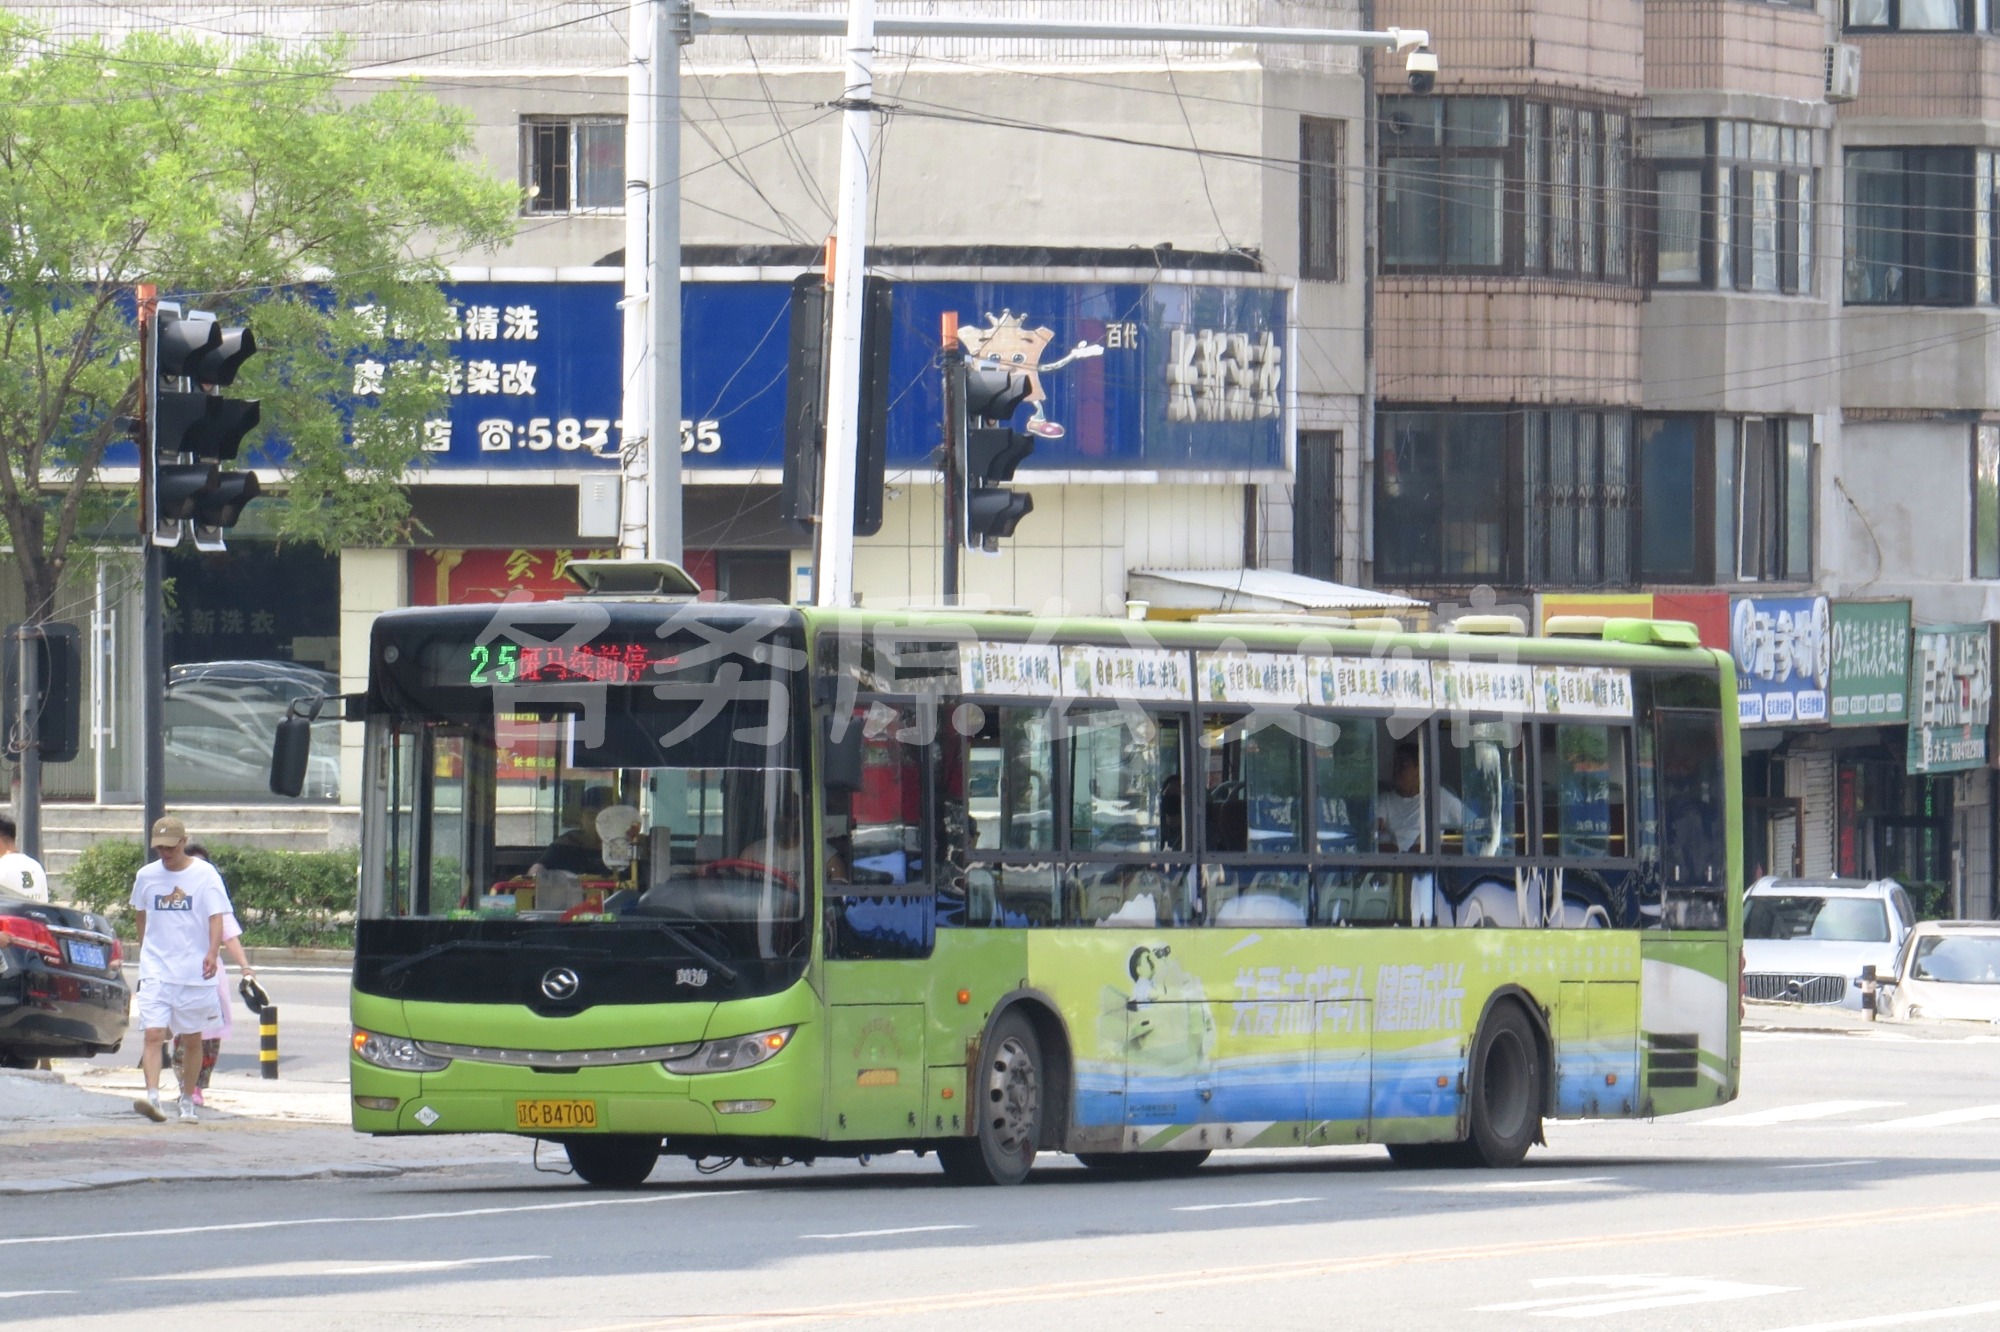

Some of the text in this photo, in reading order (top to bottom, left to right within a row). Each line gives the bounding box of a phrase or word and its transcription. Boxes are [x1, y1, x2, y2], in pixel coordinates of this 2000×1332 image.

[354, 304, 538, 340] 品精洗
[1106, 323, 1138, 350] 百代
[353, 359, 537, 395] 皮洗染改
[470, 646, 516, 683] 25
[21, 871, 34, 889] B
[158, 899, 189, 909] NSA
[675, 968, 708, 986] 黄海
[1230, 963, 1466, 1036] 关爱未成年人 健康成长
